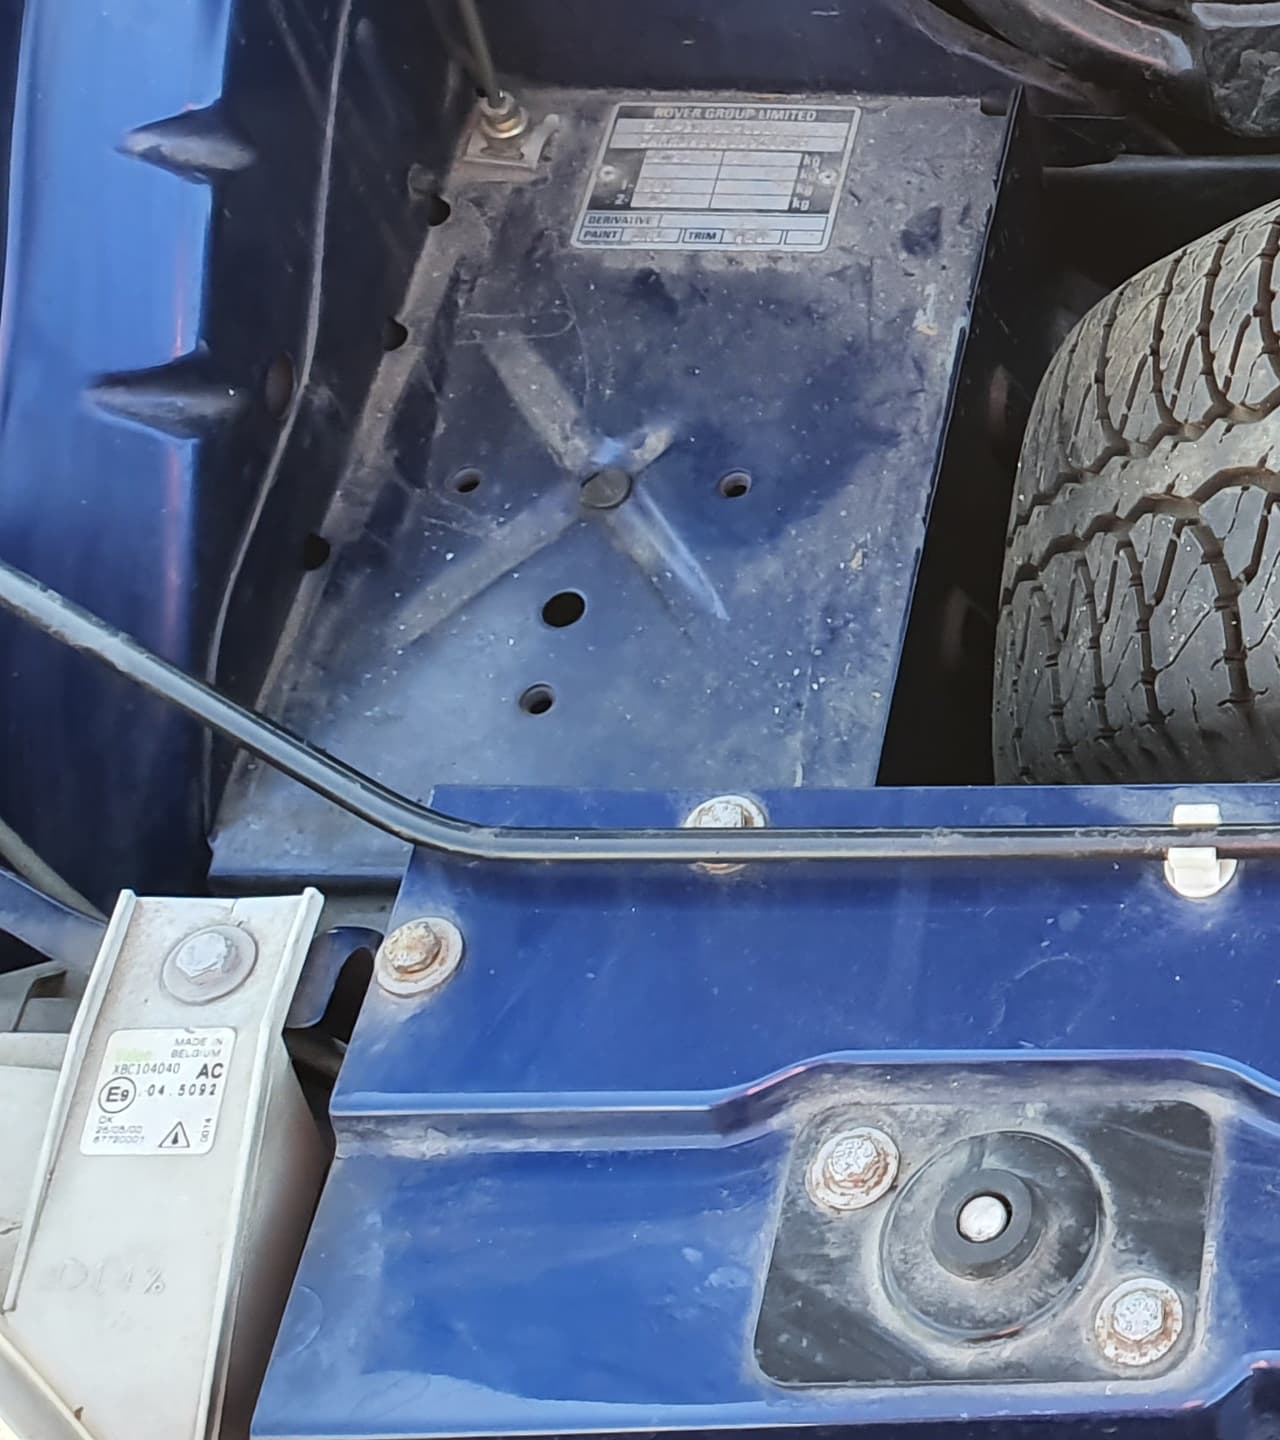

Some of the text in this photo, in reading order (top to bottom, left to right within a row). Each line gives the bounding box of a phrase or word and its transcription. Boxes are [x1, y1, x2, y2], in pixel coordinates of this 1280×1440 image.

[653, 107, 817, 122] ROVER GROUP LIMITED
[587, 214, 653, 226] DERIVATIVE
[583, 230, 619, 240] PAINT
[688, 231, 717, 241] TRIM
[170, 1049, 222, 1059] BELGIUM
[195, 1062, 224, 1080] AC
[105, 1086, 129, 1103] E9
